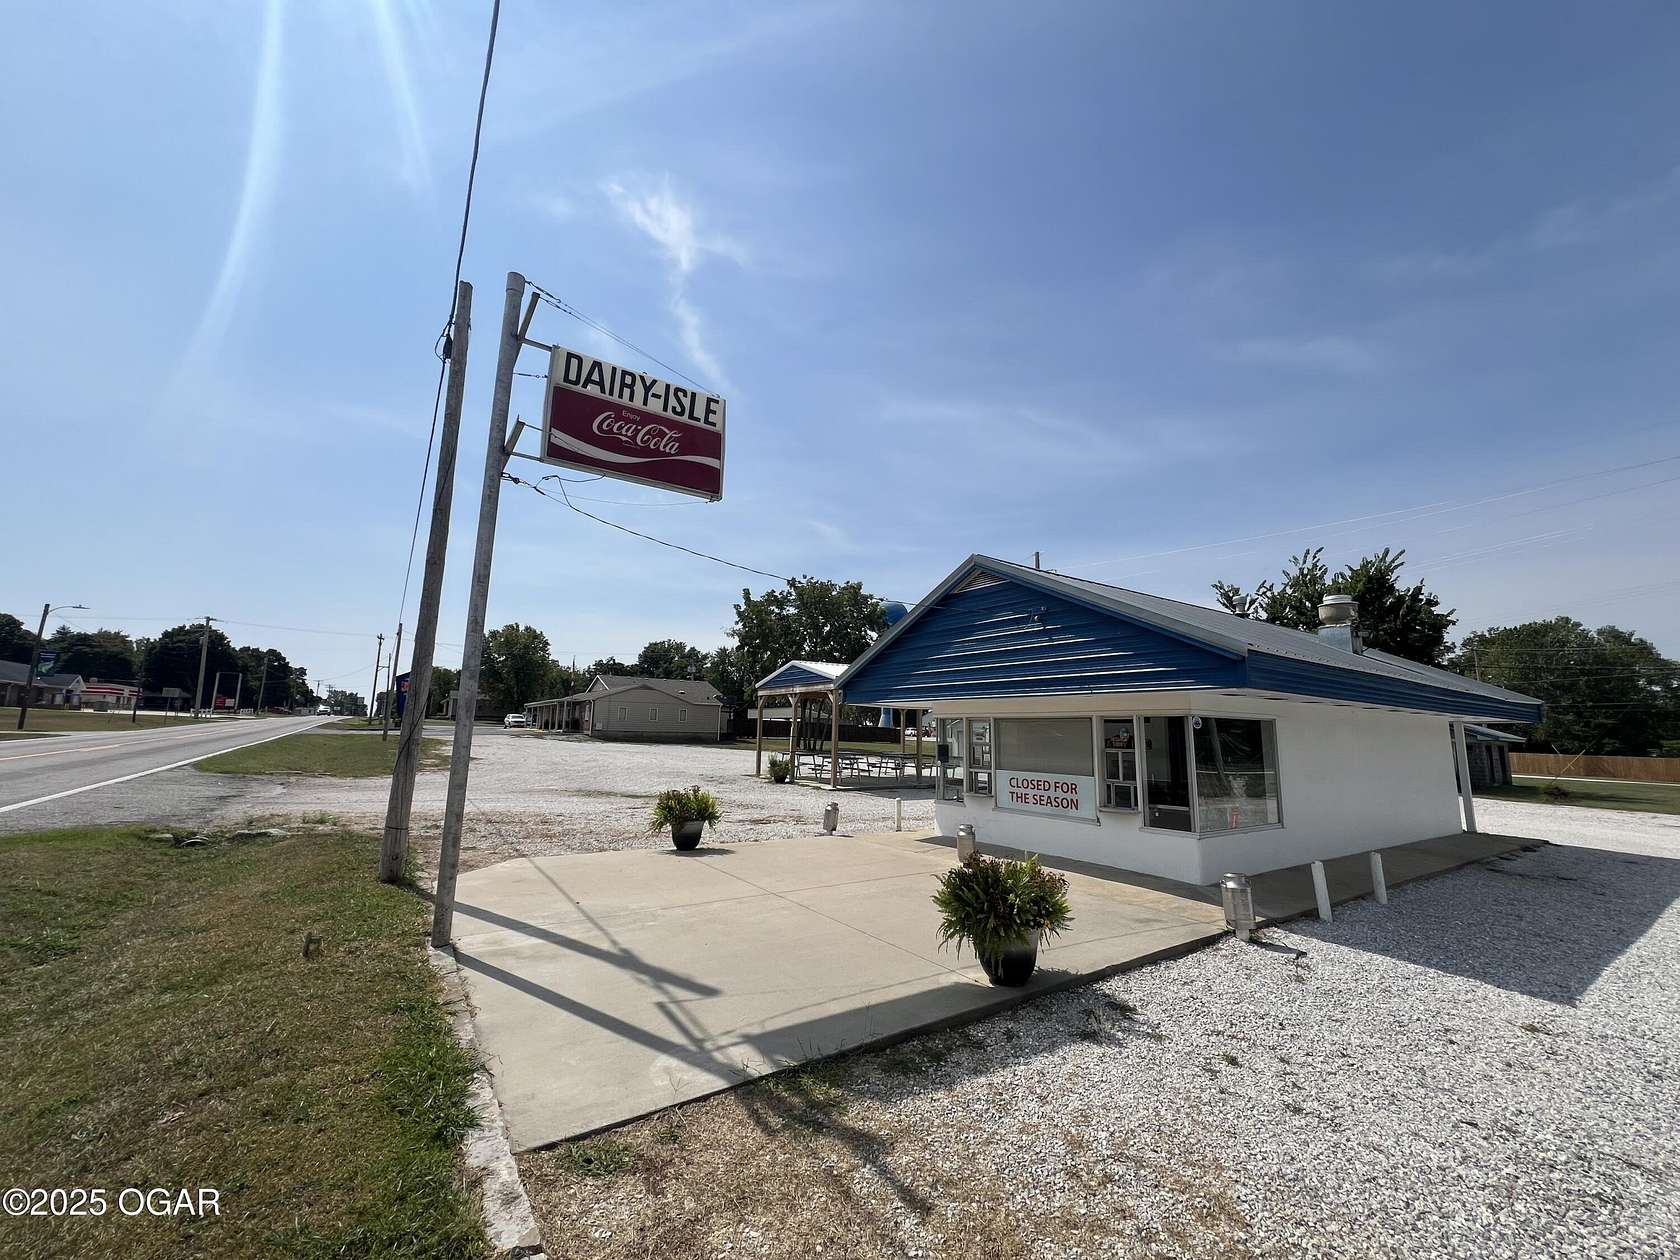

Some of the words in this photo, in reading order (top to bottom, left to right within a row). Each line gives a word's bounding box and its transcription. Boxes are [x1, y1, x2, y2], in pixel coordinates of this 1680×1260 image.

[563, 351, 720, 427] DAIRY-ISLE
[622, 409, 641, 421] Enjoy
[592, 411, 682, 454] Coca-Cola
[1009, 777, 1051, 792] CLOSED
[1054, 781, 1078, 795] FOR
[1009, 791, 1030, 804] THE
[1032, 794, 1079, 811] SEASON
